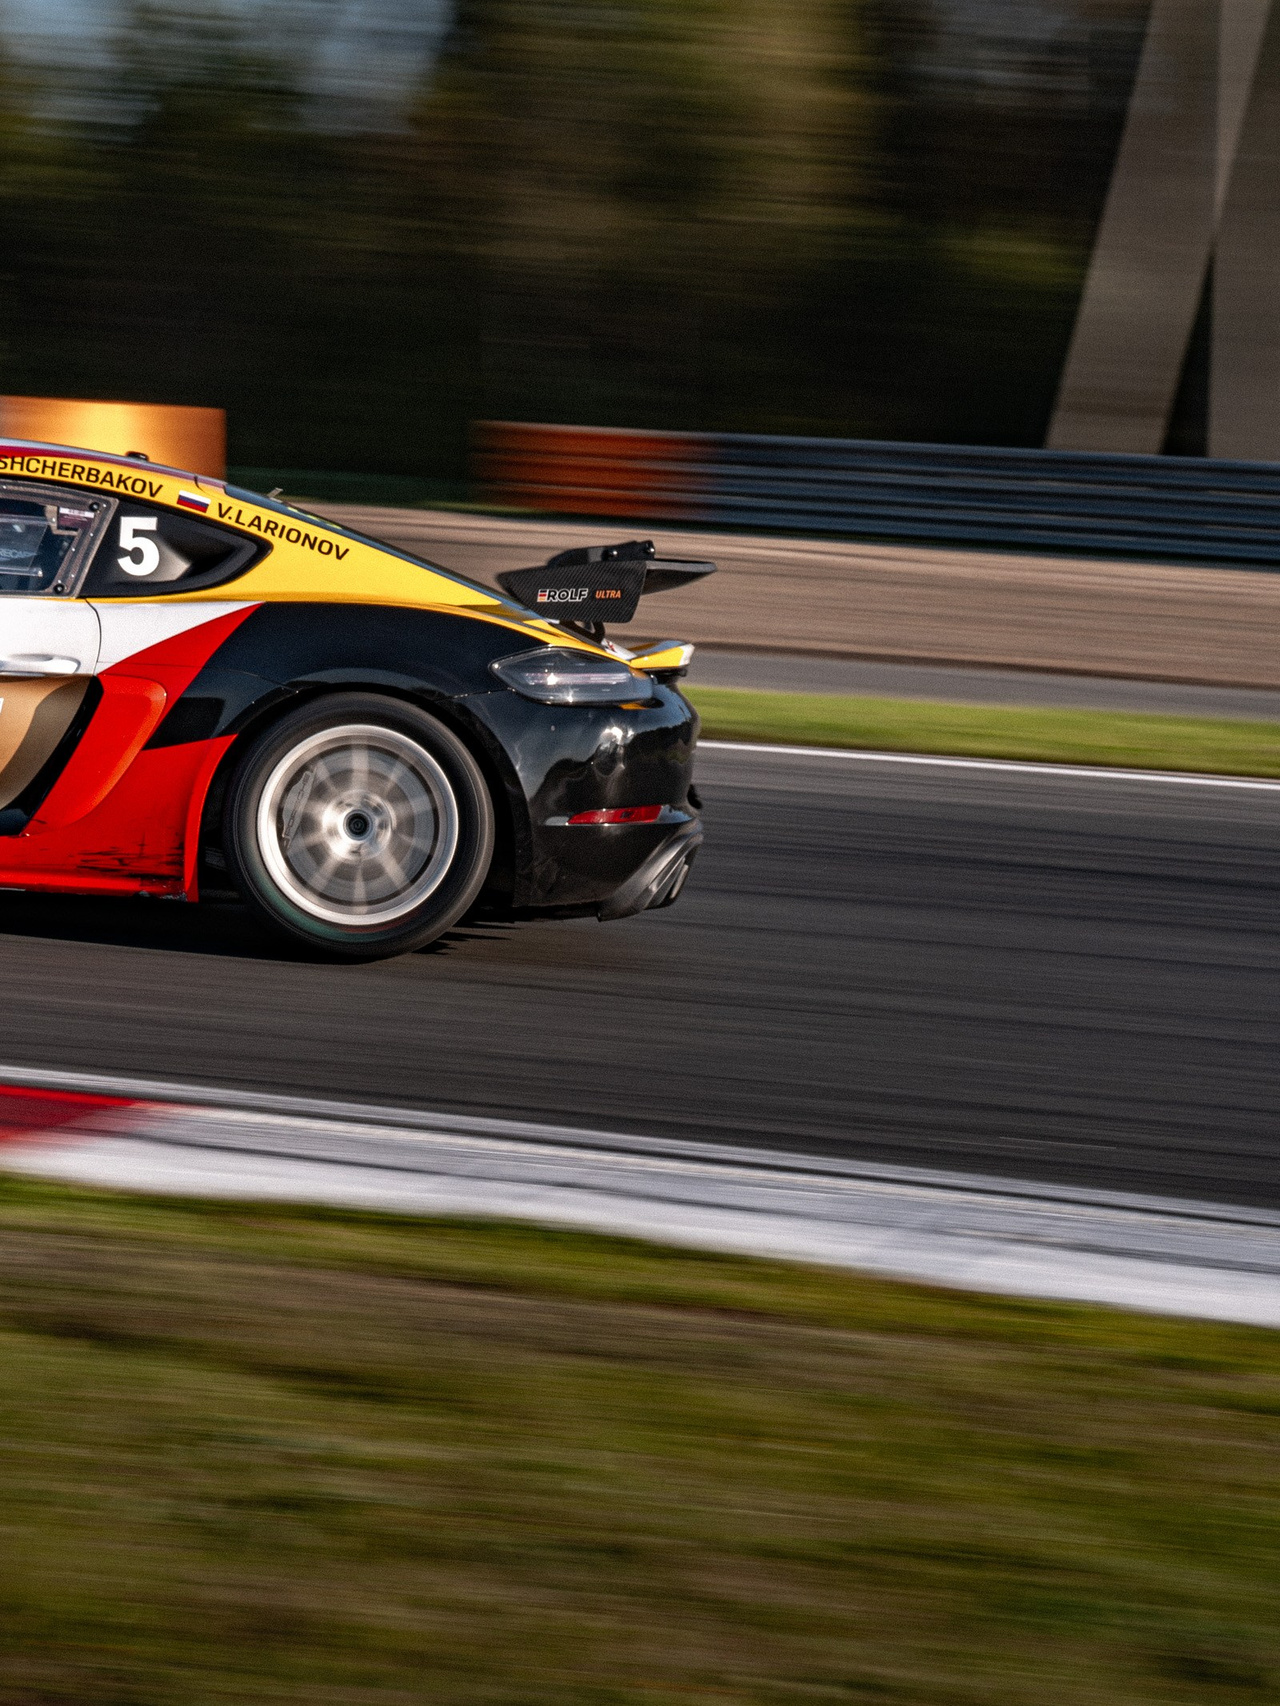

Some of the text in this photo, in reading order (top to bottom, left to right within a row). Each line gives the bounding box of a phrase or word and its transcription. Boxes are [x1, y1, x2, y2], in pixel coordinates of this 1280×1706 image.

[117, 516, 159, 576] 5
[217, 502, 350, 561] V.LARIONOV
[546, 588, 621, 602] ROLF ULTRA
